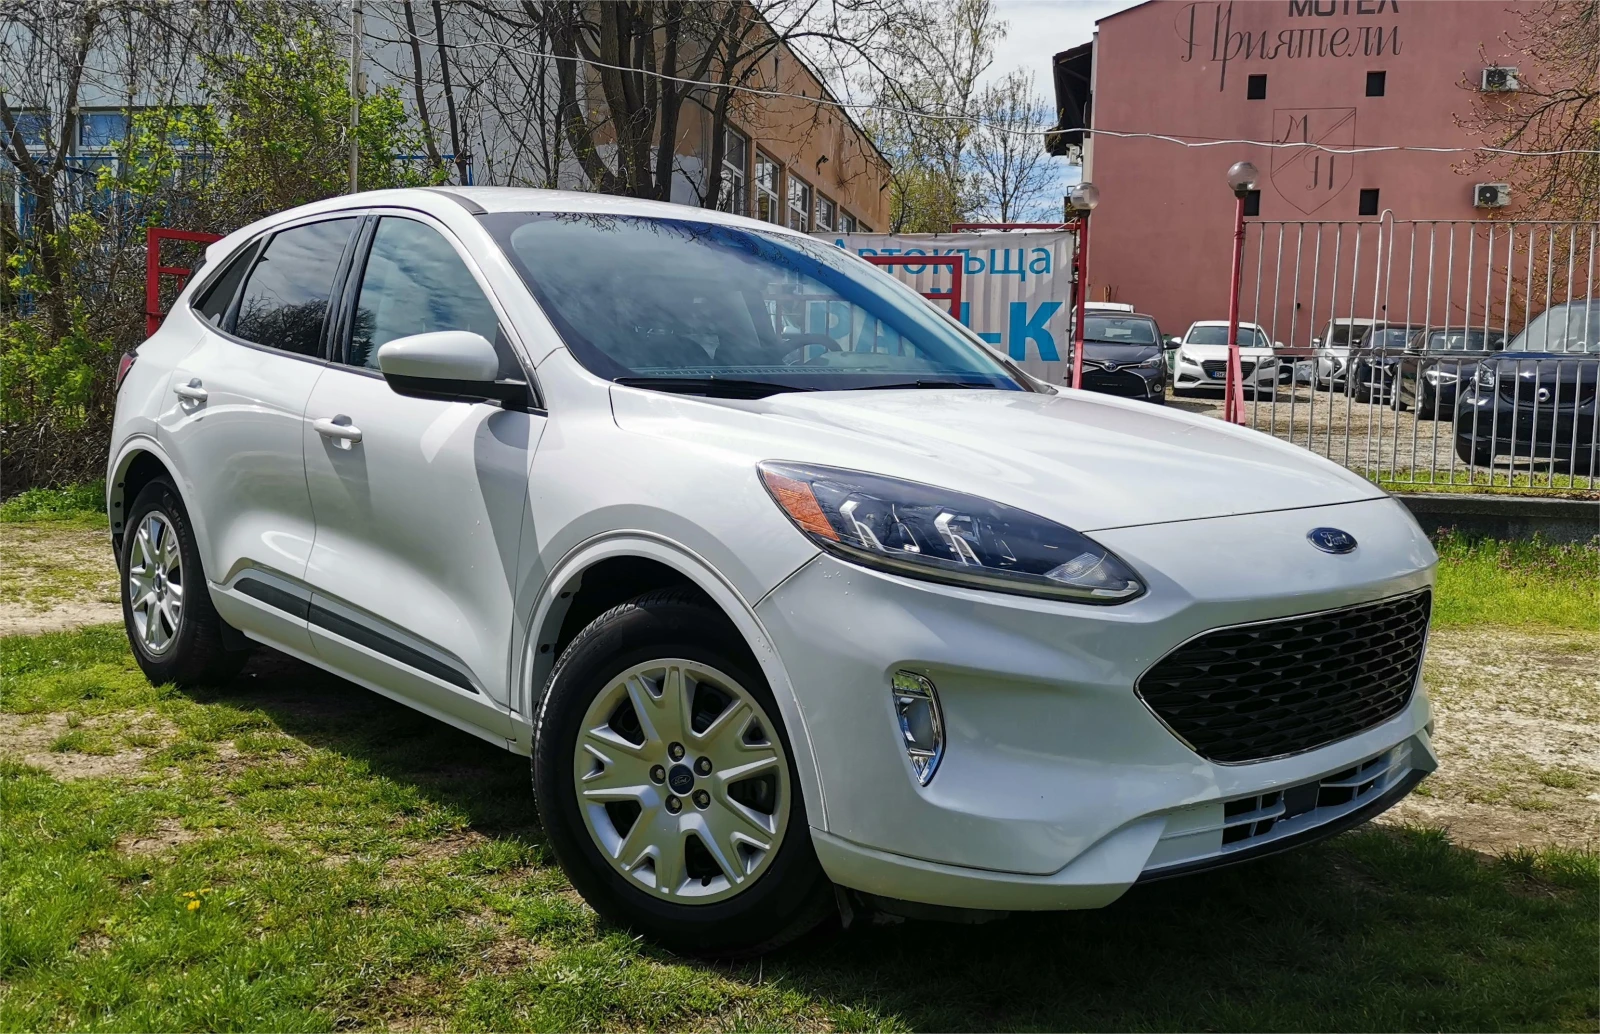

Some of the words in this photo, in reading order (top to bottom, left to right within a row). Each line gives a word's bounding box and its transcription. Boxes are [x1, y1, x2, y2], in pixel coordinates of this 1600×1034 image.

[1174, 0, 1403, 92] Приятели
[834, 238, 1051, 282] токъща
[809, 287, 1063, 362] РА-К
[1320, 531, 1349, 547] Ford
